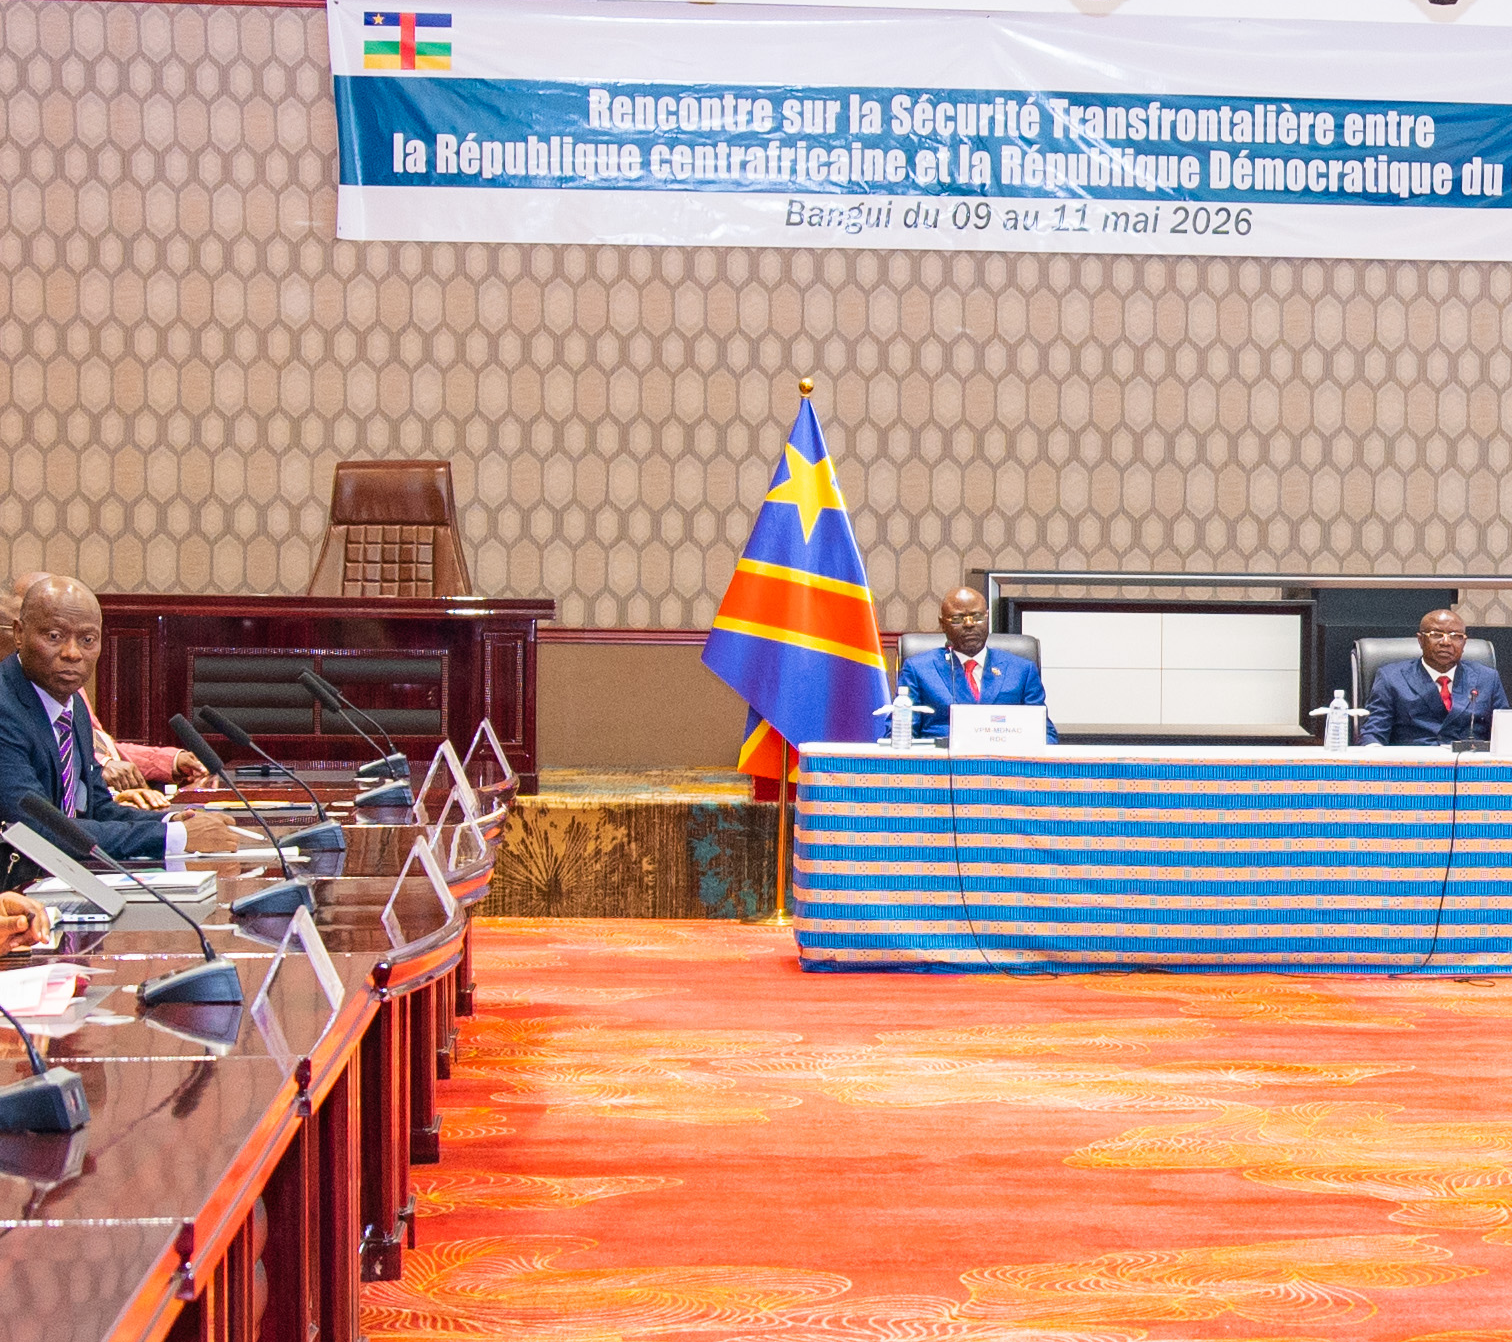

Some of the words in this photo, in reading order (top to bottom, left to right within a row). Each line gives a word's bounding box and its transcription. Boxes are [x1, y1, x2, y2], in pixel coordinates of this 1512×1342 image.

[589, 88, 773, 133] Rencontre
[782, 97, 840, 134] sur
[849, 93, 882, 134] la
[891, 92, 1041, 138] Sécurité
[1051, 98, 1335, 146] Transfrontalière
[1344, 110, 1435, 148] entre
[392, 133, 427, 174] la
[436, 132, 641, 180] République
[650, 140, 906, 184] centrafricaine
[915, 147, 951, 184] et
[959, 143, 991, 185] la
[1001, 144, 1200, 193] République
[1209, 149, 1452, 199] Démocratique
[1461, 156, 1503, 196] du
[784, 199, 892, 234] Bangui
[903, 202, 939, 229] du
[951, 203, 991, 230] 09
[1002, 209, 1040, 232] au
[1053, 203, 1089, 232] 11
[1101, 206, 1159, 234] mai
[1170, 205, 1253, 236] 2026
